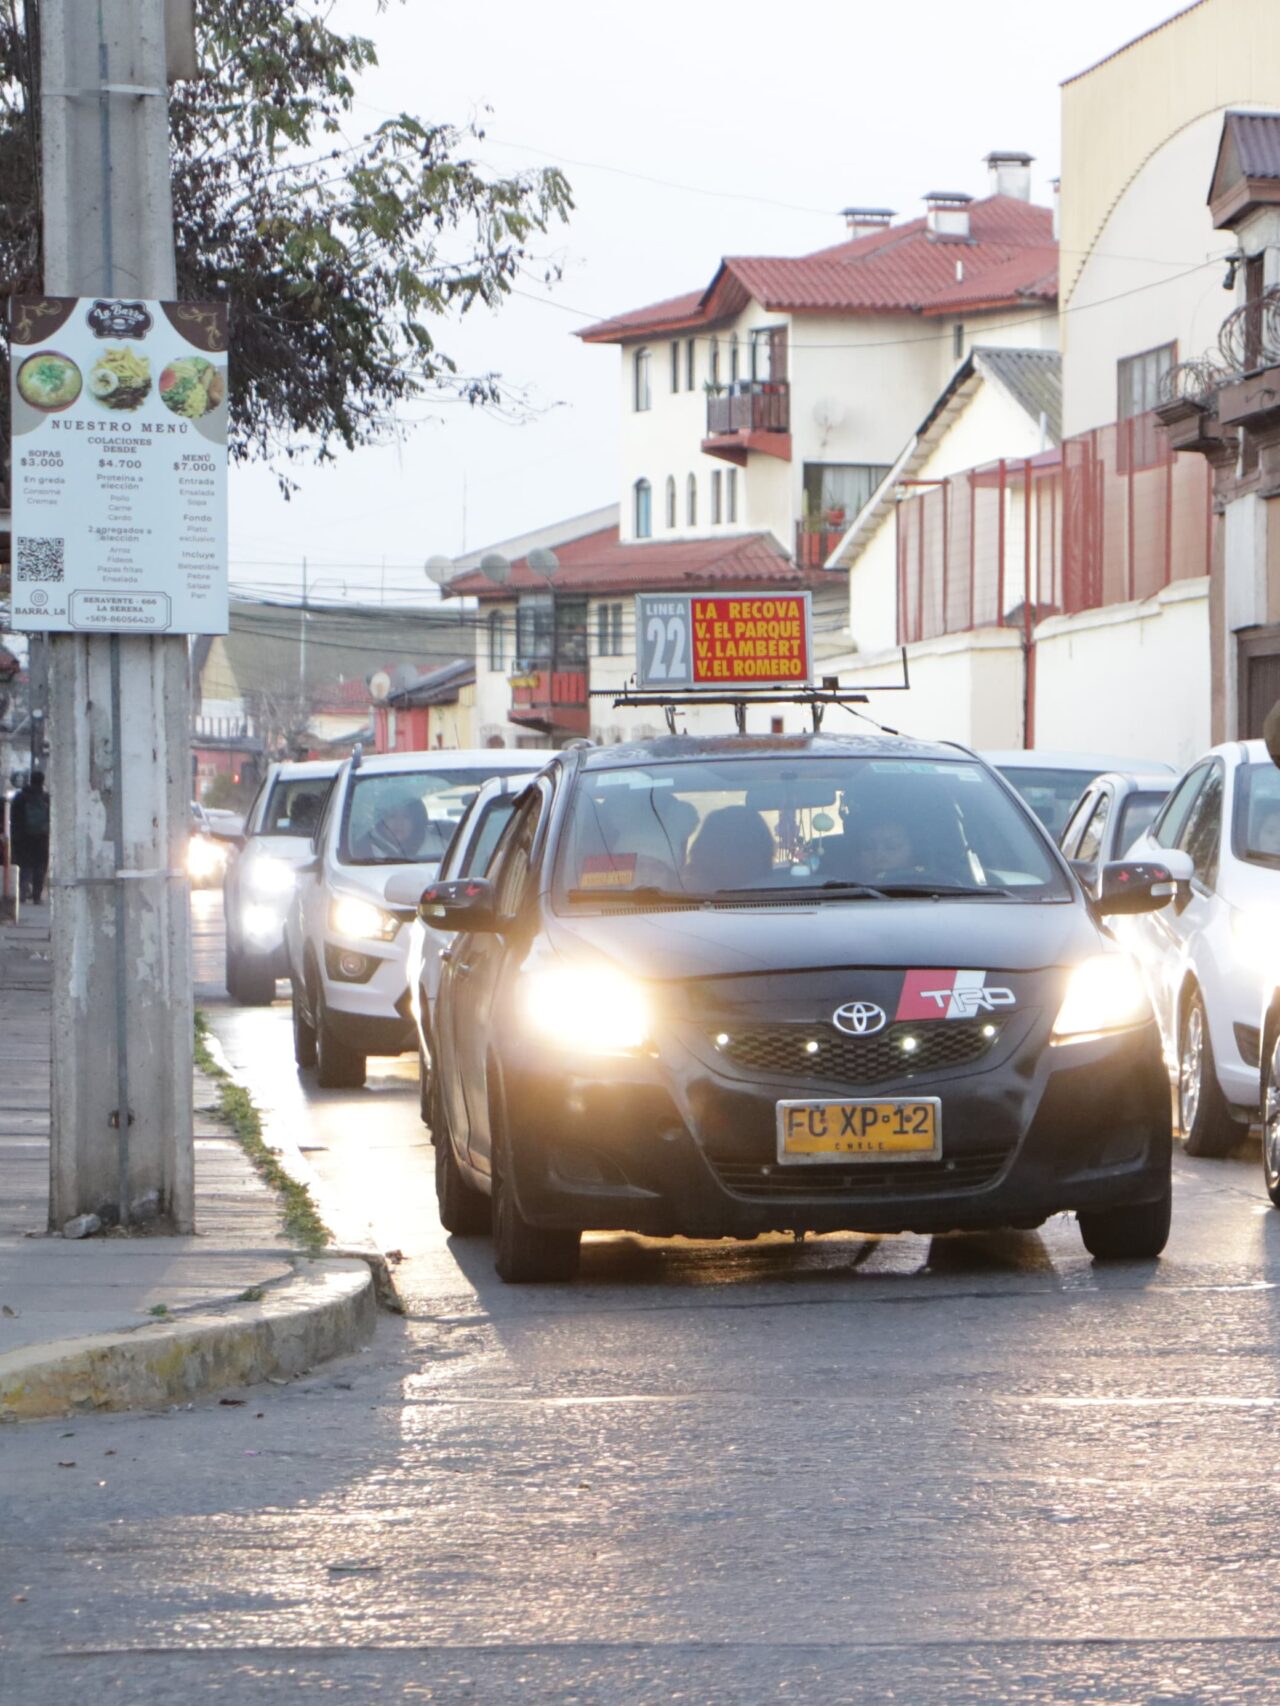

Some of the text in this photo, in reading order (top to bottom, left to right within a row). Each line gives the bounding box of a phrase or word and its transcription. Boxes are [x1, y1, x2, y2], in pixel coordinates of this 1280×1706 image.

[51, 420, 188, 434] NUESTRO MENÚ
[87, 436, 152, 446] COLACIONES
[28, 450, 61, 458] SOPAS
[182, 453, 211, 462] MENÚ
[20, 458, 64, 467] $3.000
[98, 459, 142, 468] $4.700
[173, 462, 217, 471] $7.000
[38, 477, 65, 485] greda
[100, 481, 139, 489] elección
[178, 477, 215, 485] Entrada
[183, 514, 213, 522] Fondo
[95, 527, 144, 536] agregados
[182, 551, 215, 559] Incluye
[83, 596, 133, 605] BENAVENTE
[15, 606, 66, 616] BARRA_LS
[646, 603, 685, 615] LINEA
[695, 601, 799, 619] LA RECOVA
[695, 620, 800, 640] V. EL PARQUE
[647, 617, 686, 678] 22
[696, 640, 800, 657] V. LAMBERT
[697, 659, 801, 677] V. EL ROMERO
[920, 987, 1016, 1012] TRD
